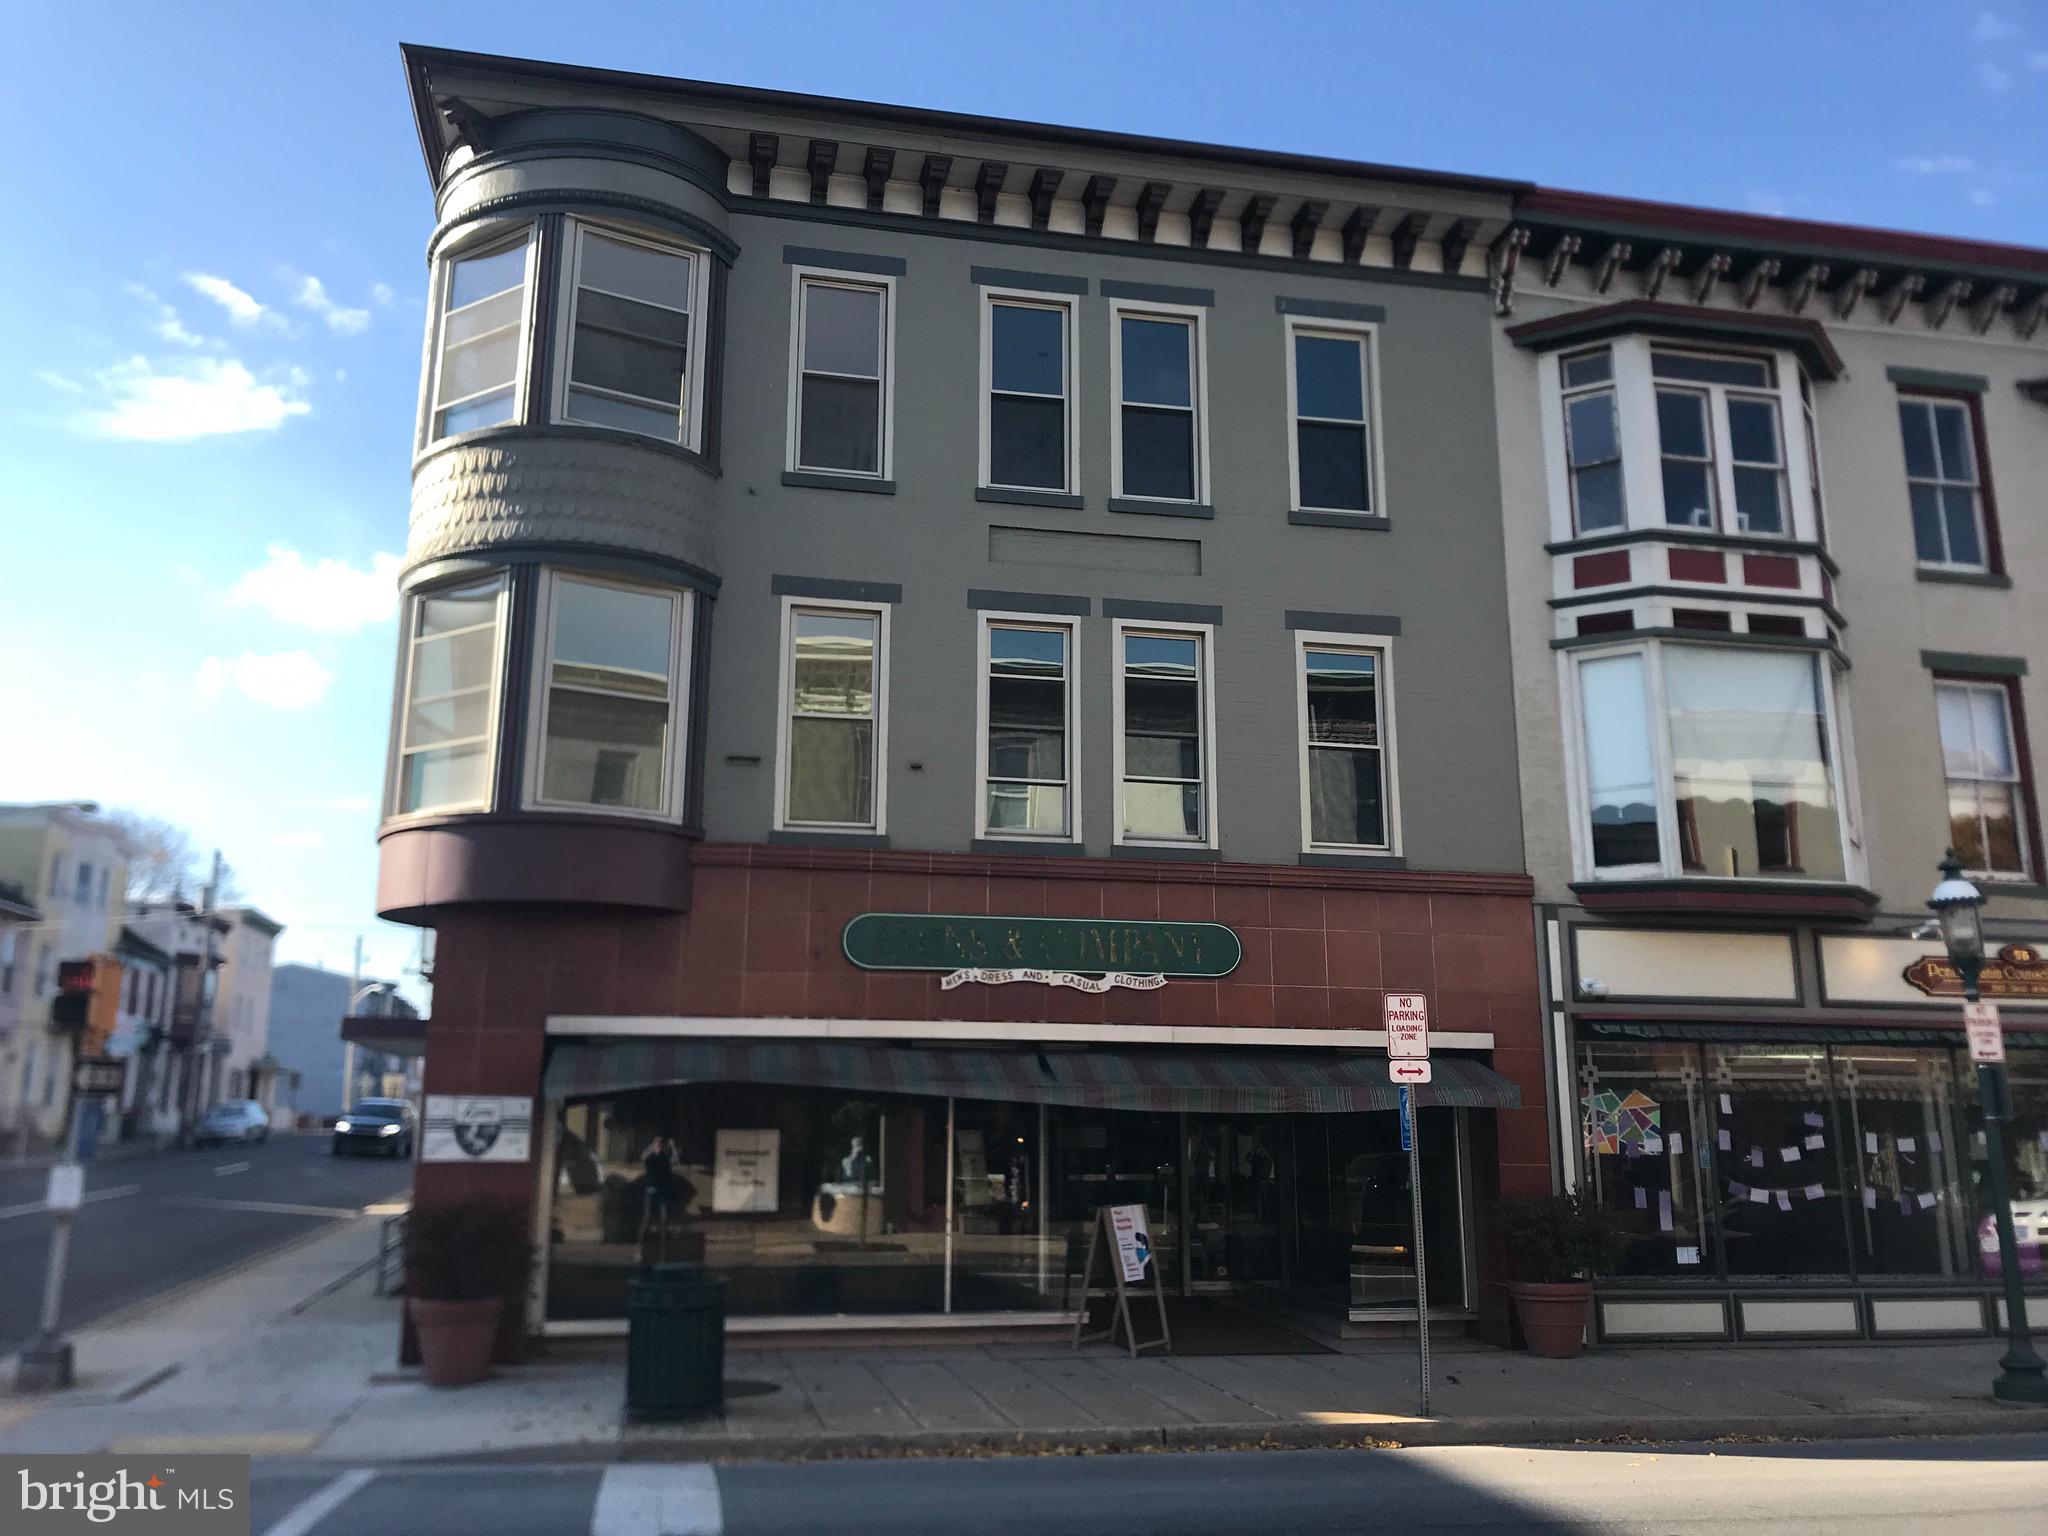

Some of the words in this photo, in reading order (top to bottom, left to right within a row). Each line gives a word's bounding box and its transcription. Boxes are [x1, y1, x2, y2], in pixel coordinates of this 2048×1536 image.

[980, 970, 1014, 982] DRESS
[1022, 970, 1043, 981] AND
[1062, 974, 1102, 991] CASUAL
[1399, 997, 1412, 1008] NO
[1388, 1010, 1424, 1021] PARKING
[1391, 1024, 1423, 1033] LOADING
